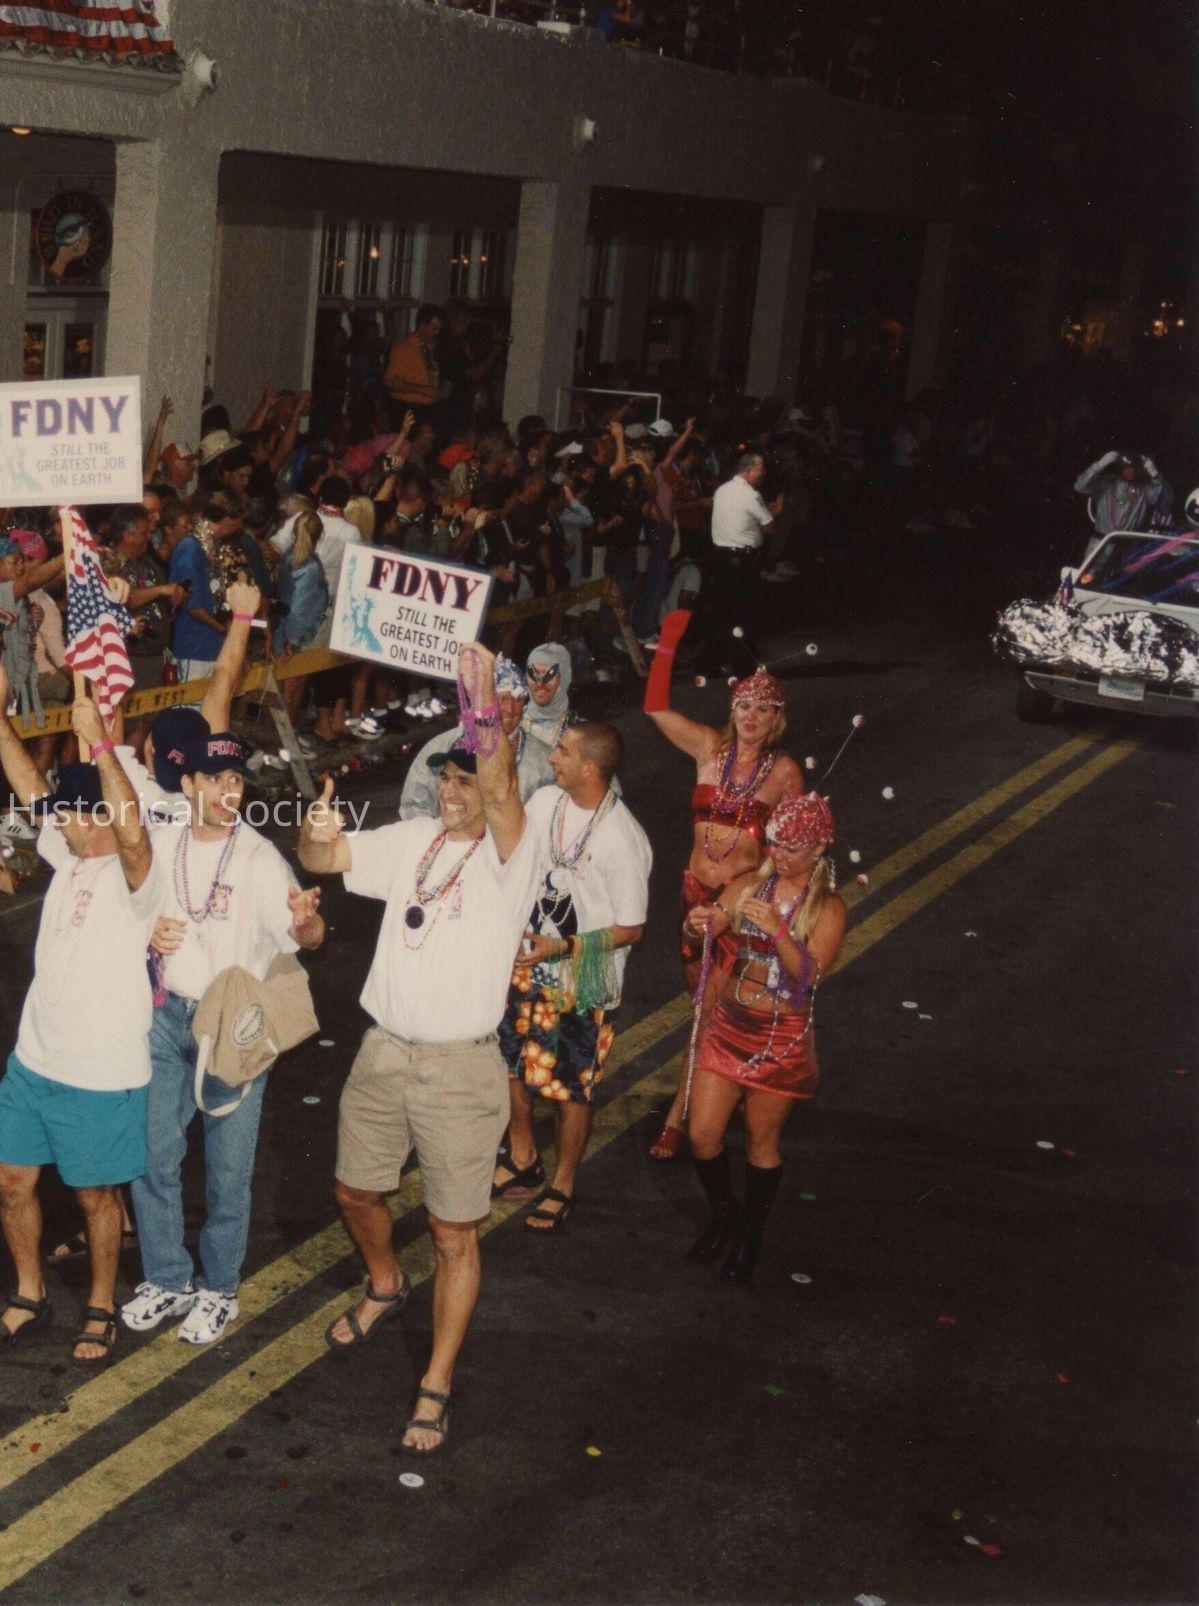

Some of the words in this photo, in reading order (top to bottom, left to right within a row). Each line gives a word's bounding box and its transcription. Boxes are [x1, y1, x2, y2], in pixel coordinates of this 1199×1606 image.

[10, 395, 130, 438] FDNY
[51, 443, 84, 457] STILL
[88, 442, 111, 455] THE
[36, 458, 97, 473] GREATEST
[102, 456, 126, 470] JOB
[51, 474, 68, 487] ON
[72, 472, 112, 486] EARTH
[366, 555, 483, 612] FDNY
[396, 606, 427, 627] STILL
[433, 615, 457, 635] THE
[380, 622, 441, 650] GREATEST
[390, 644, 408, 662] ON
[412, 650, 452, 673] EARTH
